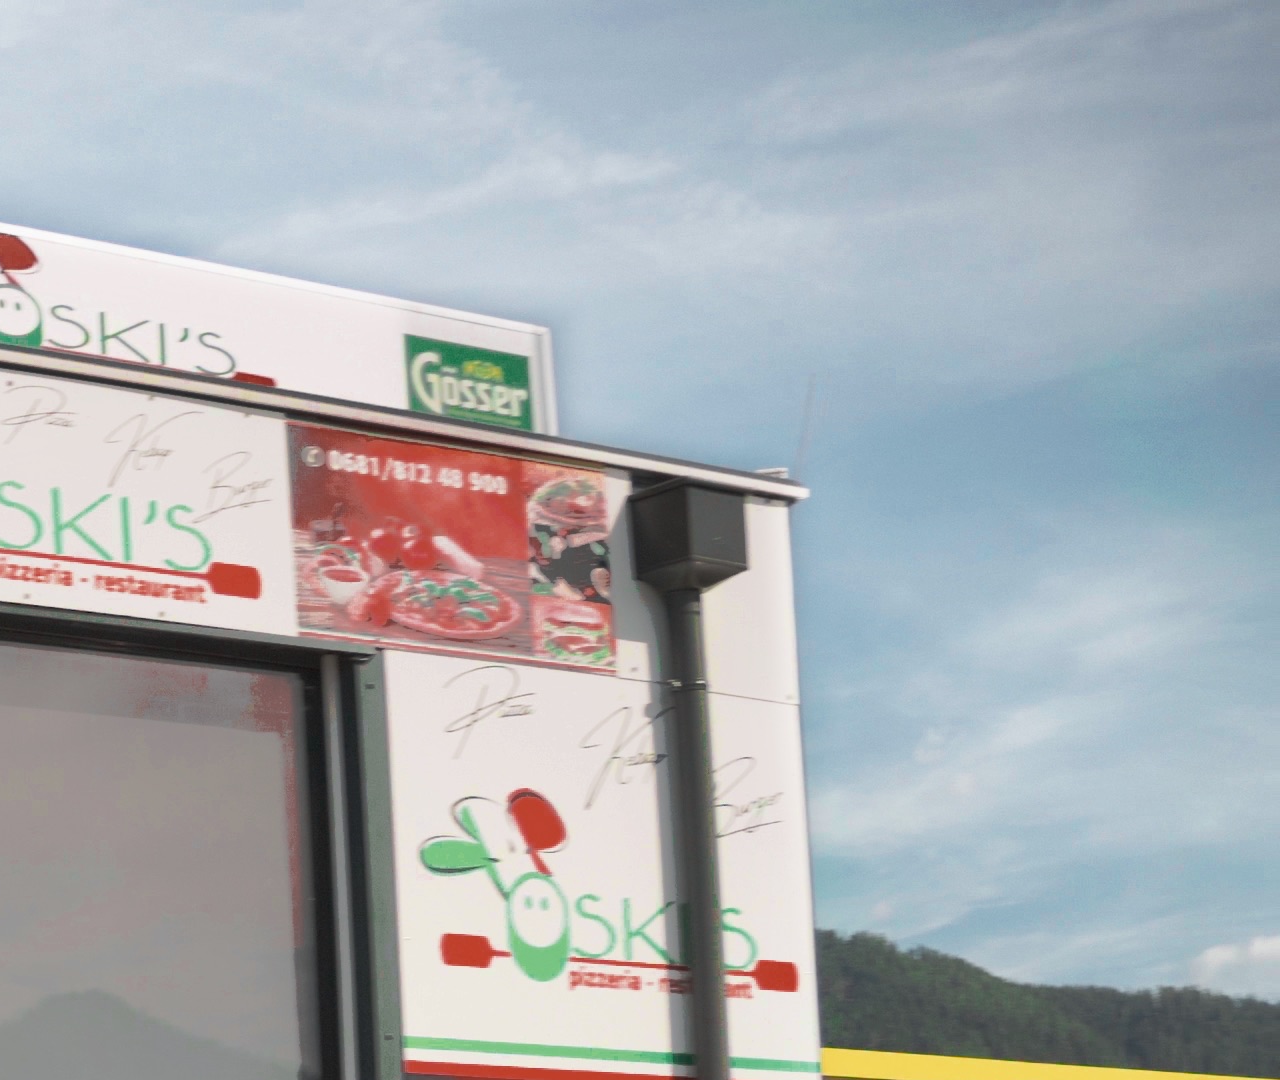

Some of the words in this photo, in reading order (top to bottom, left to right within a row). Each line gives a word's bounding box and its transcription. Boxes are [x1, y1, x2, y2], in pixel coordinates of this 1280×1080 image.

[411, 352, 529, 417] Gösser
[328, 450, 433, 485] 0681/812
[437, 467, 464, 489] 48
[468, 472, 509, 495] 900
[94, 574, 207, 604] restaurant
[569, 965, 641, 991] pizzeria
